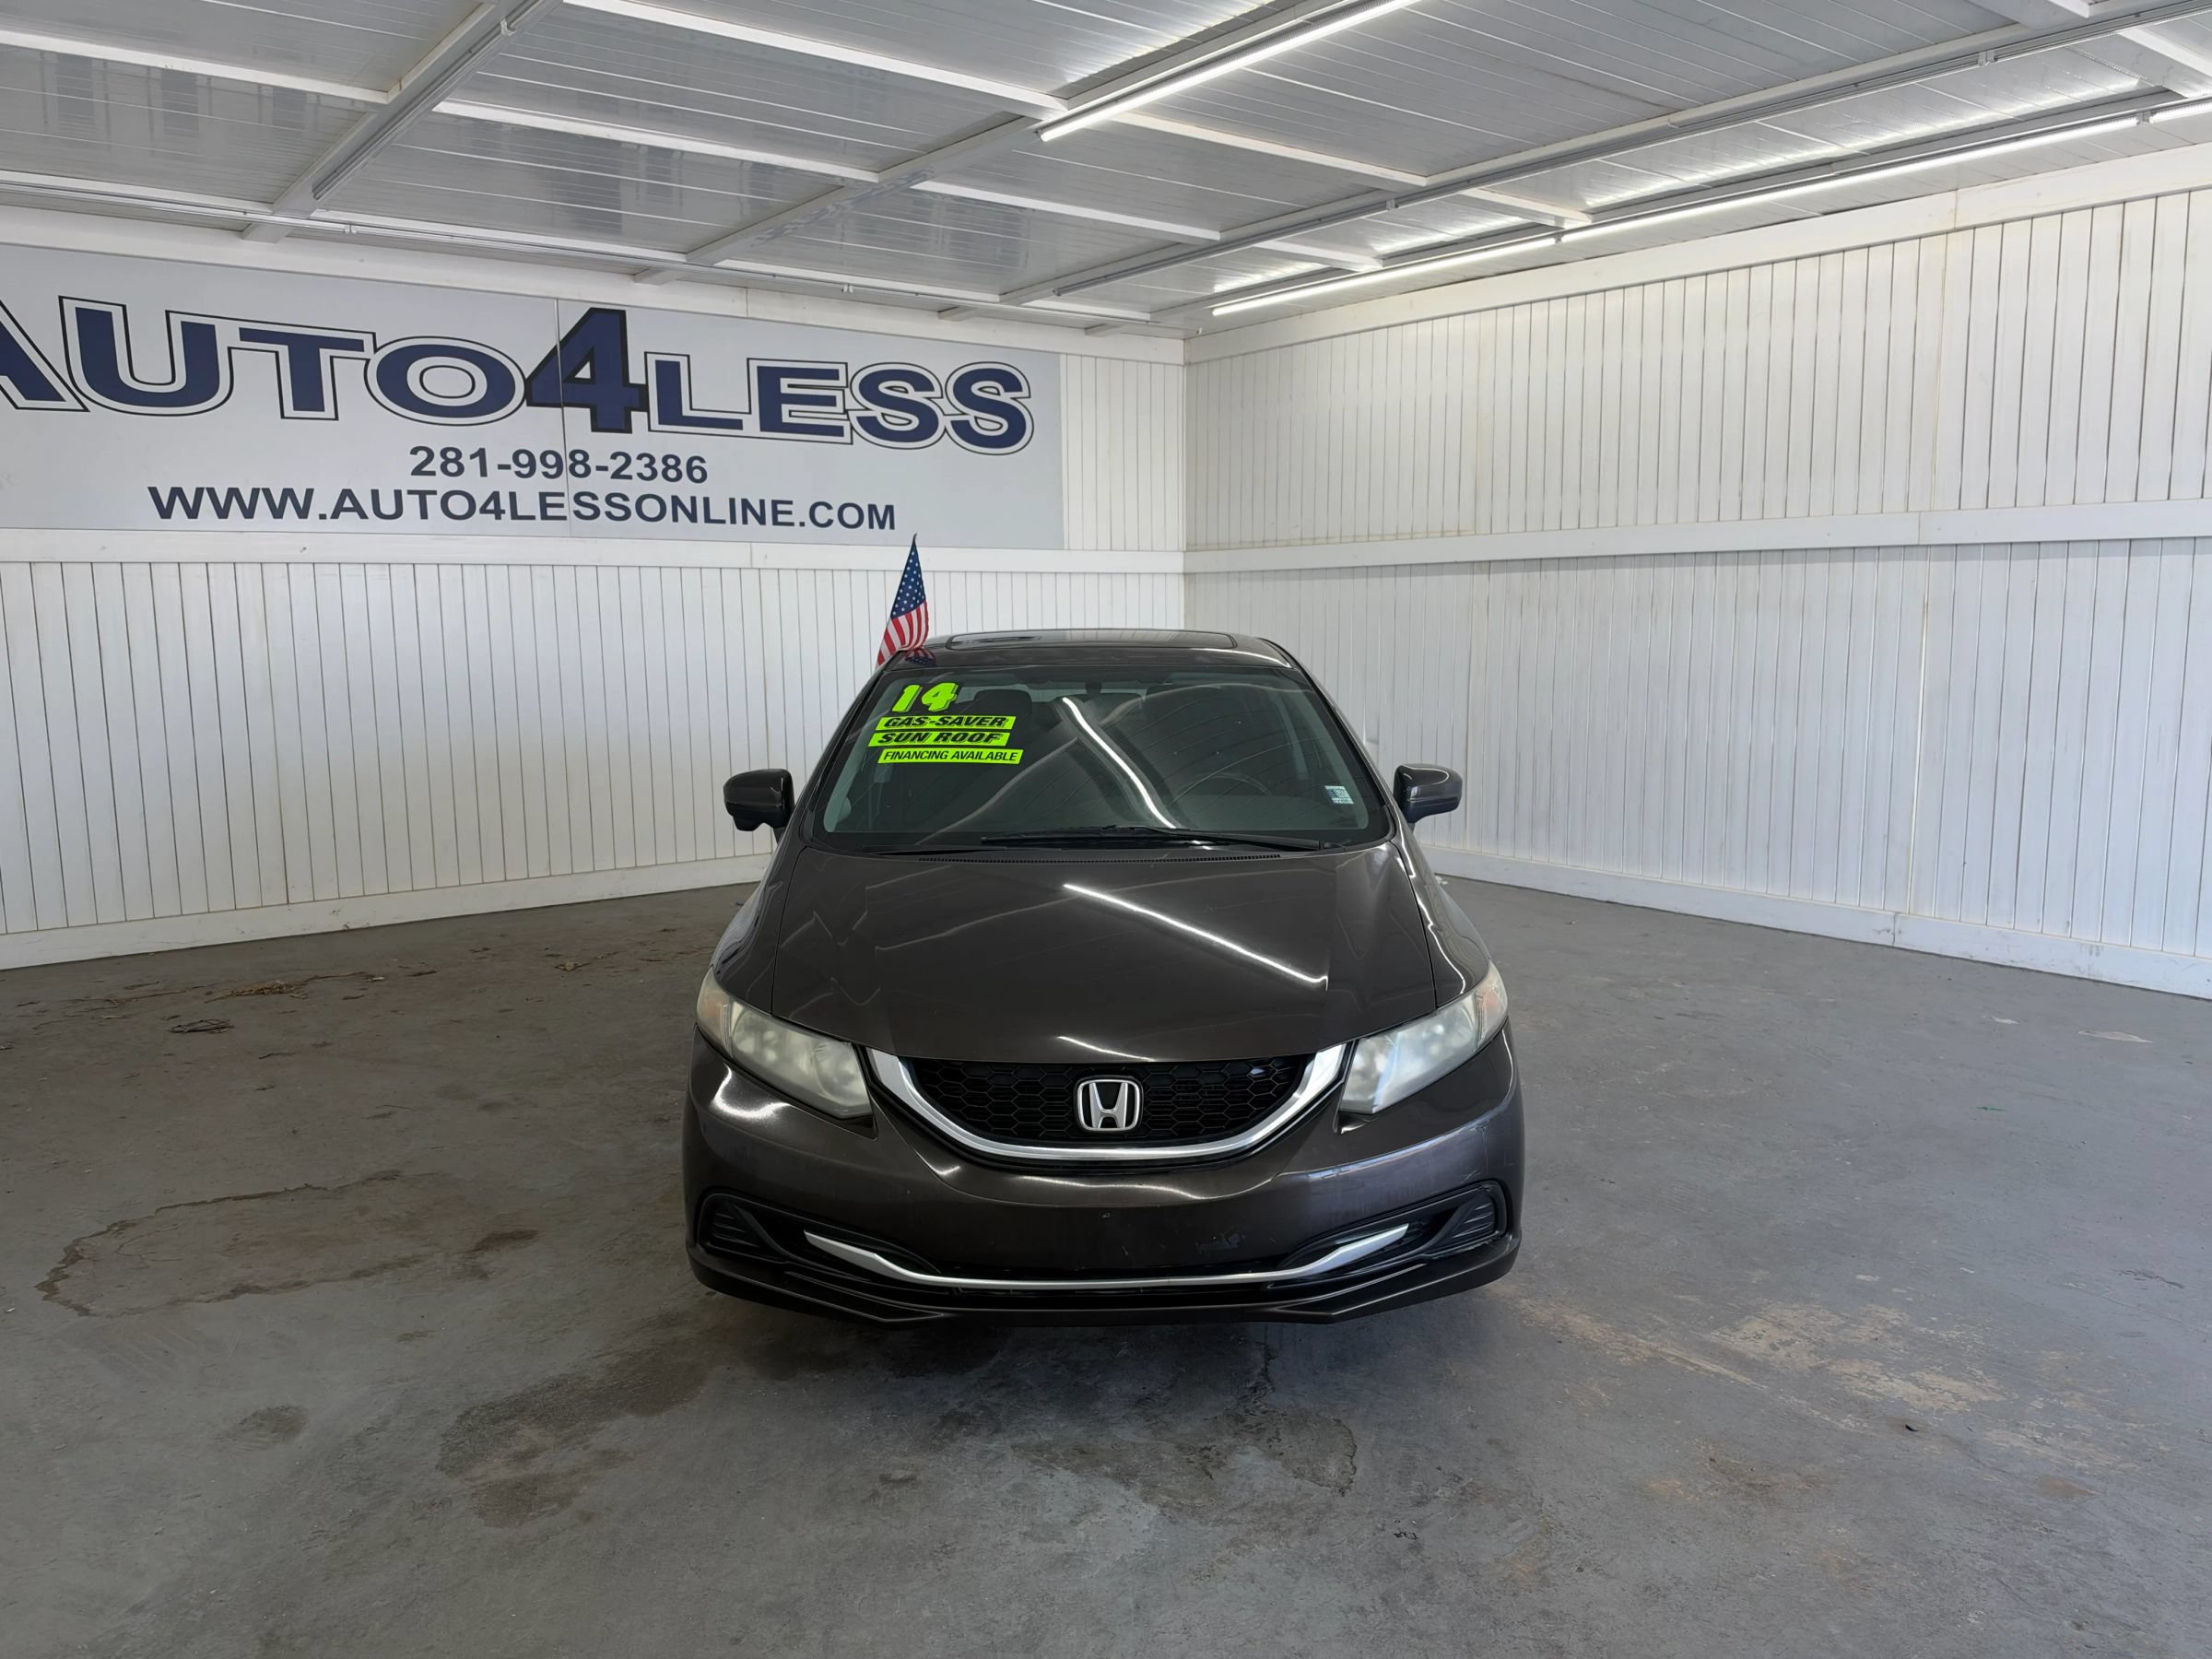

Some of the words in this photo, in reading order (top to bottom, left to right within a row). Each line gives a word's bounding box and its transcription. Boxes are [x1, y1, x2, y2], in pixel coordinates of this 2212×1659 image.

[409, 445, 708, 484] 281-998-2386
[147, 486, 896, 531] WWW.AUTO4LESSONLINE.COM
[891, 682, 959, 712] 14
[884, 716, 1009, 728] GAS-SAVER
[877, 733, 930, 744] SUN
[934, 733, 1002, 744] ROOF
[883, 750, 948, 760] FINANCING
[951, 750, 1018, 761] AVAILABLE
